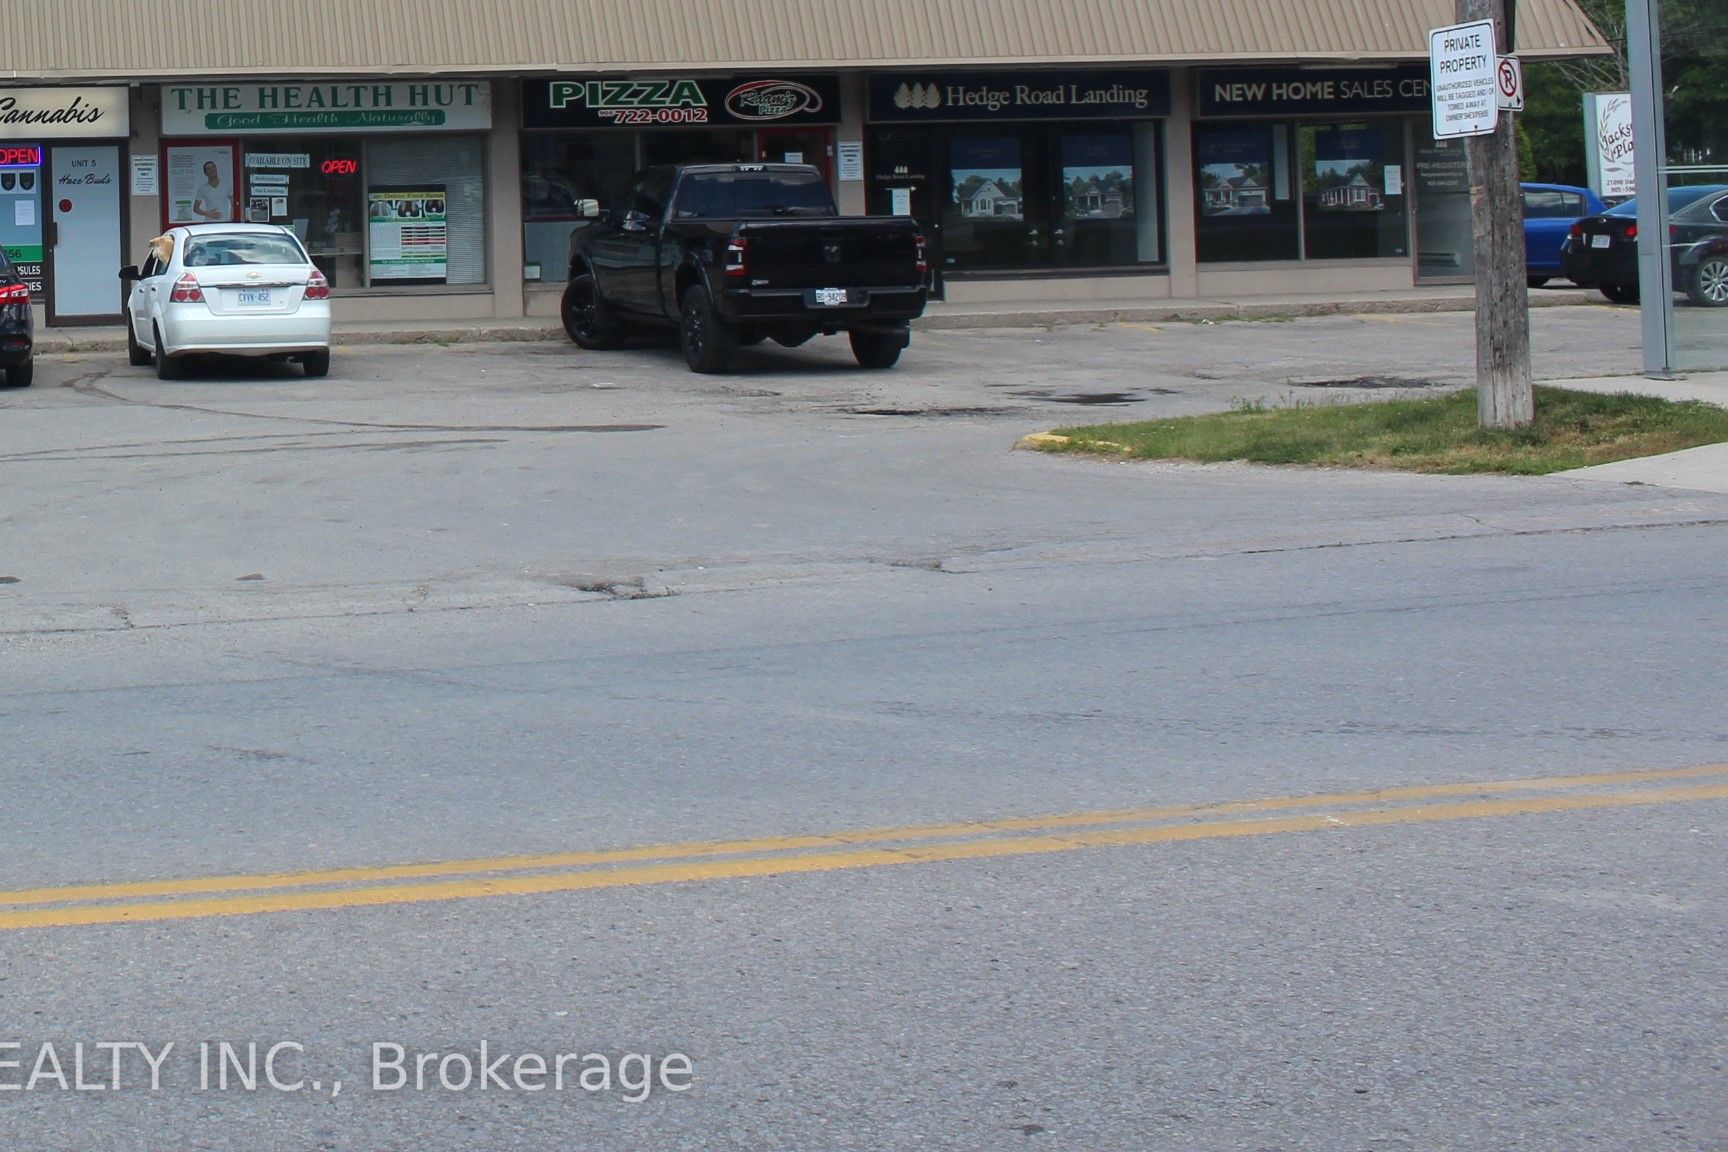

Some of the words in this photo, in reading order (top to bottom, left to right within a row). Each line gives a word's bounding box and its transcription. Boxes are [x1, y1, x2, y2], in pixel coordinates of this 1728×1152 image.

[1444, 34, 1481, 53] PRIVATE
[1440, 54, 1488, 74] PROPERTY
[1214, 83, 1266, 102] NEW
[1272, 81, 1334, 100] HOME
[1340, 80, 1393, 98] SALES
[1398, 78, 1432, 97] CEN
[1436, 80, 1473, 91] UNAUTHORIZED
[1473, 77, 1494, 87] VEHICLES
[172, 87, 241, 110] THE
[258, 85, 392, 109] HEALTH
[409, 84, 479, 107] HUT
[550, 80, 707, 108] PIZZA
[946, 86, 1010, 111] Hedge
[1014, 85, 1065, 105] Road
[1070, 84, 1148, 109] Landing
[1455, 91, 1476, 100] TAGGED
[758, 104, 788, 115] Pizza
[1465, 100, 1480, 109] AWAY
[1481, 99, 1487, 107] AT
[217, 114, 261, 128] Good
[273, 111, 338, 125] Health
[346, 109, 436, 126] Naturally
[613, 108, 708, 124] 722-0012
[1602, 122, 1633, 149] Jacks
[1613, 140, 1634, 161] Pla
[71, 160, 88, 168] UNIT
[248, 156, 280, 165] AVAILABLE
[292, 157, 307, 165] SITE
[321, 160, 357, 174] OPEN
[58, 173, 83, 185] Haze
[84, 172, 112, 185] Buds
